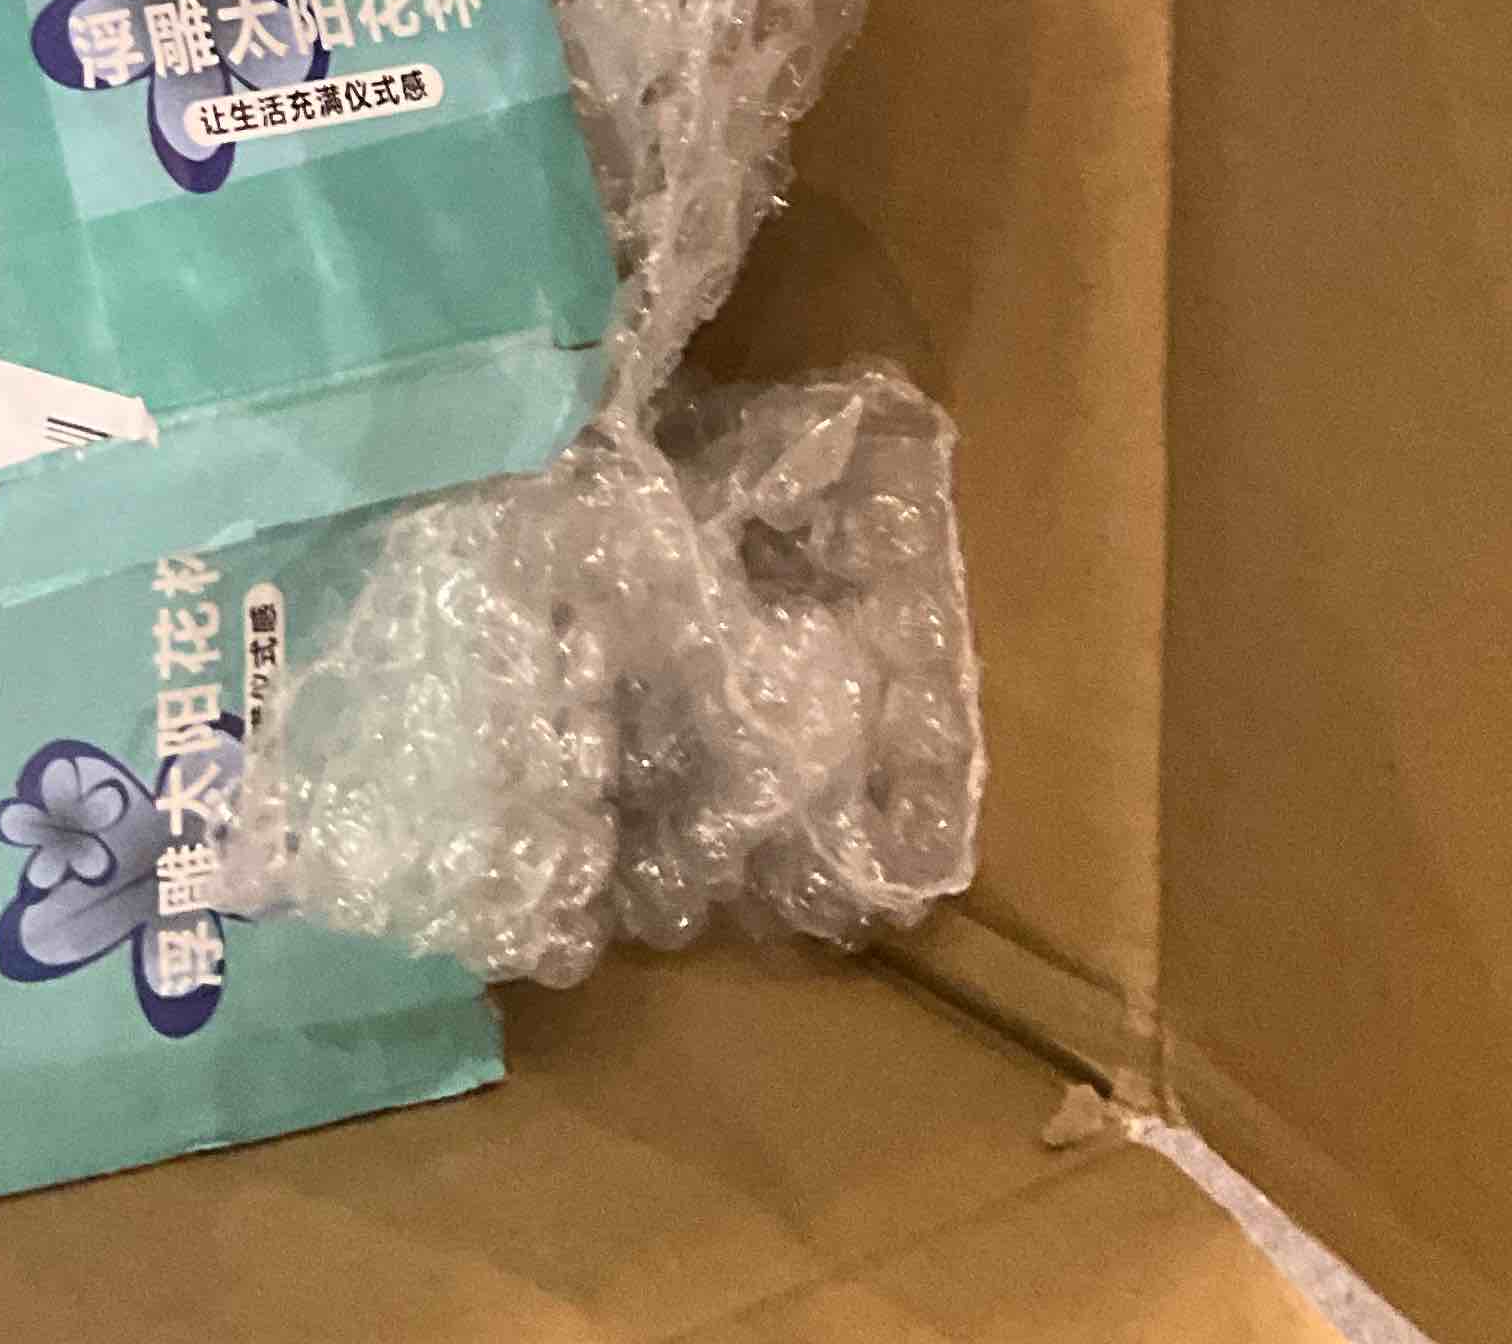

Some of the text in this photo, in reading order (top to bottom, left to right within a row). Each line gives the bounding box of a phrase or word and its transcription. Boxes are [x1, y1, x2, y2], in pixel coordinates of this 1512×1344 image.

[199, 68, 430, 138] 让生活充满仪式感
